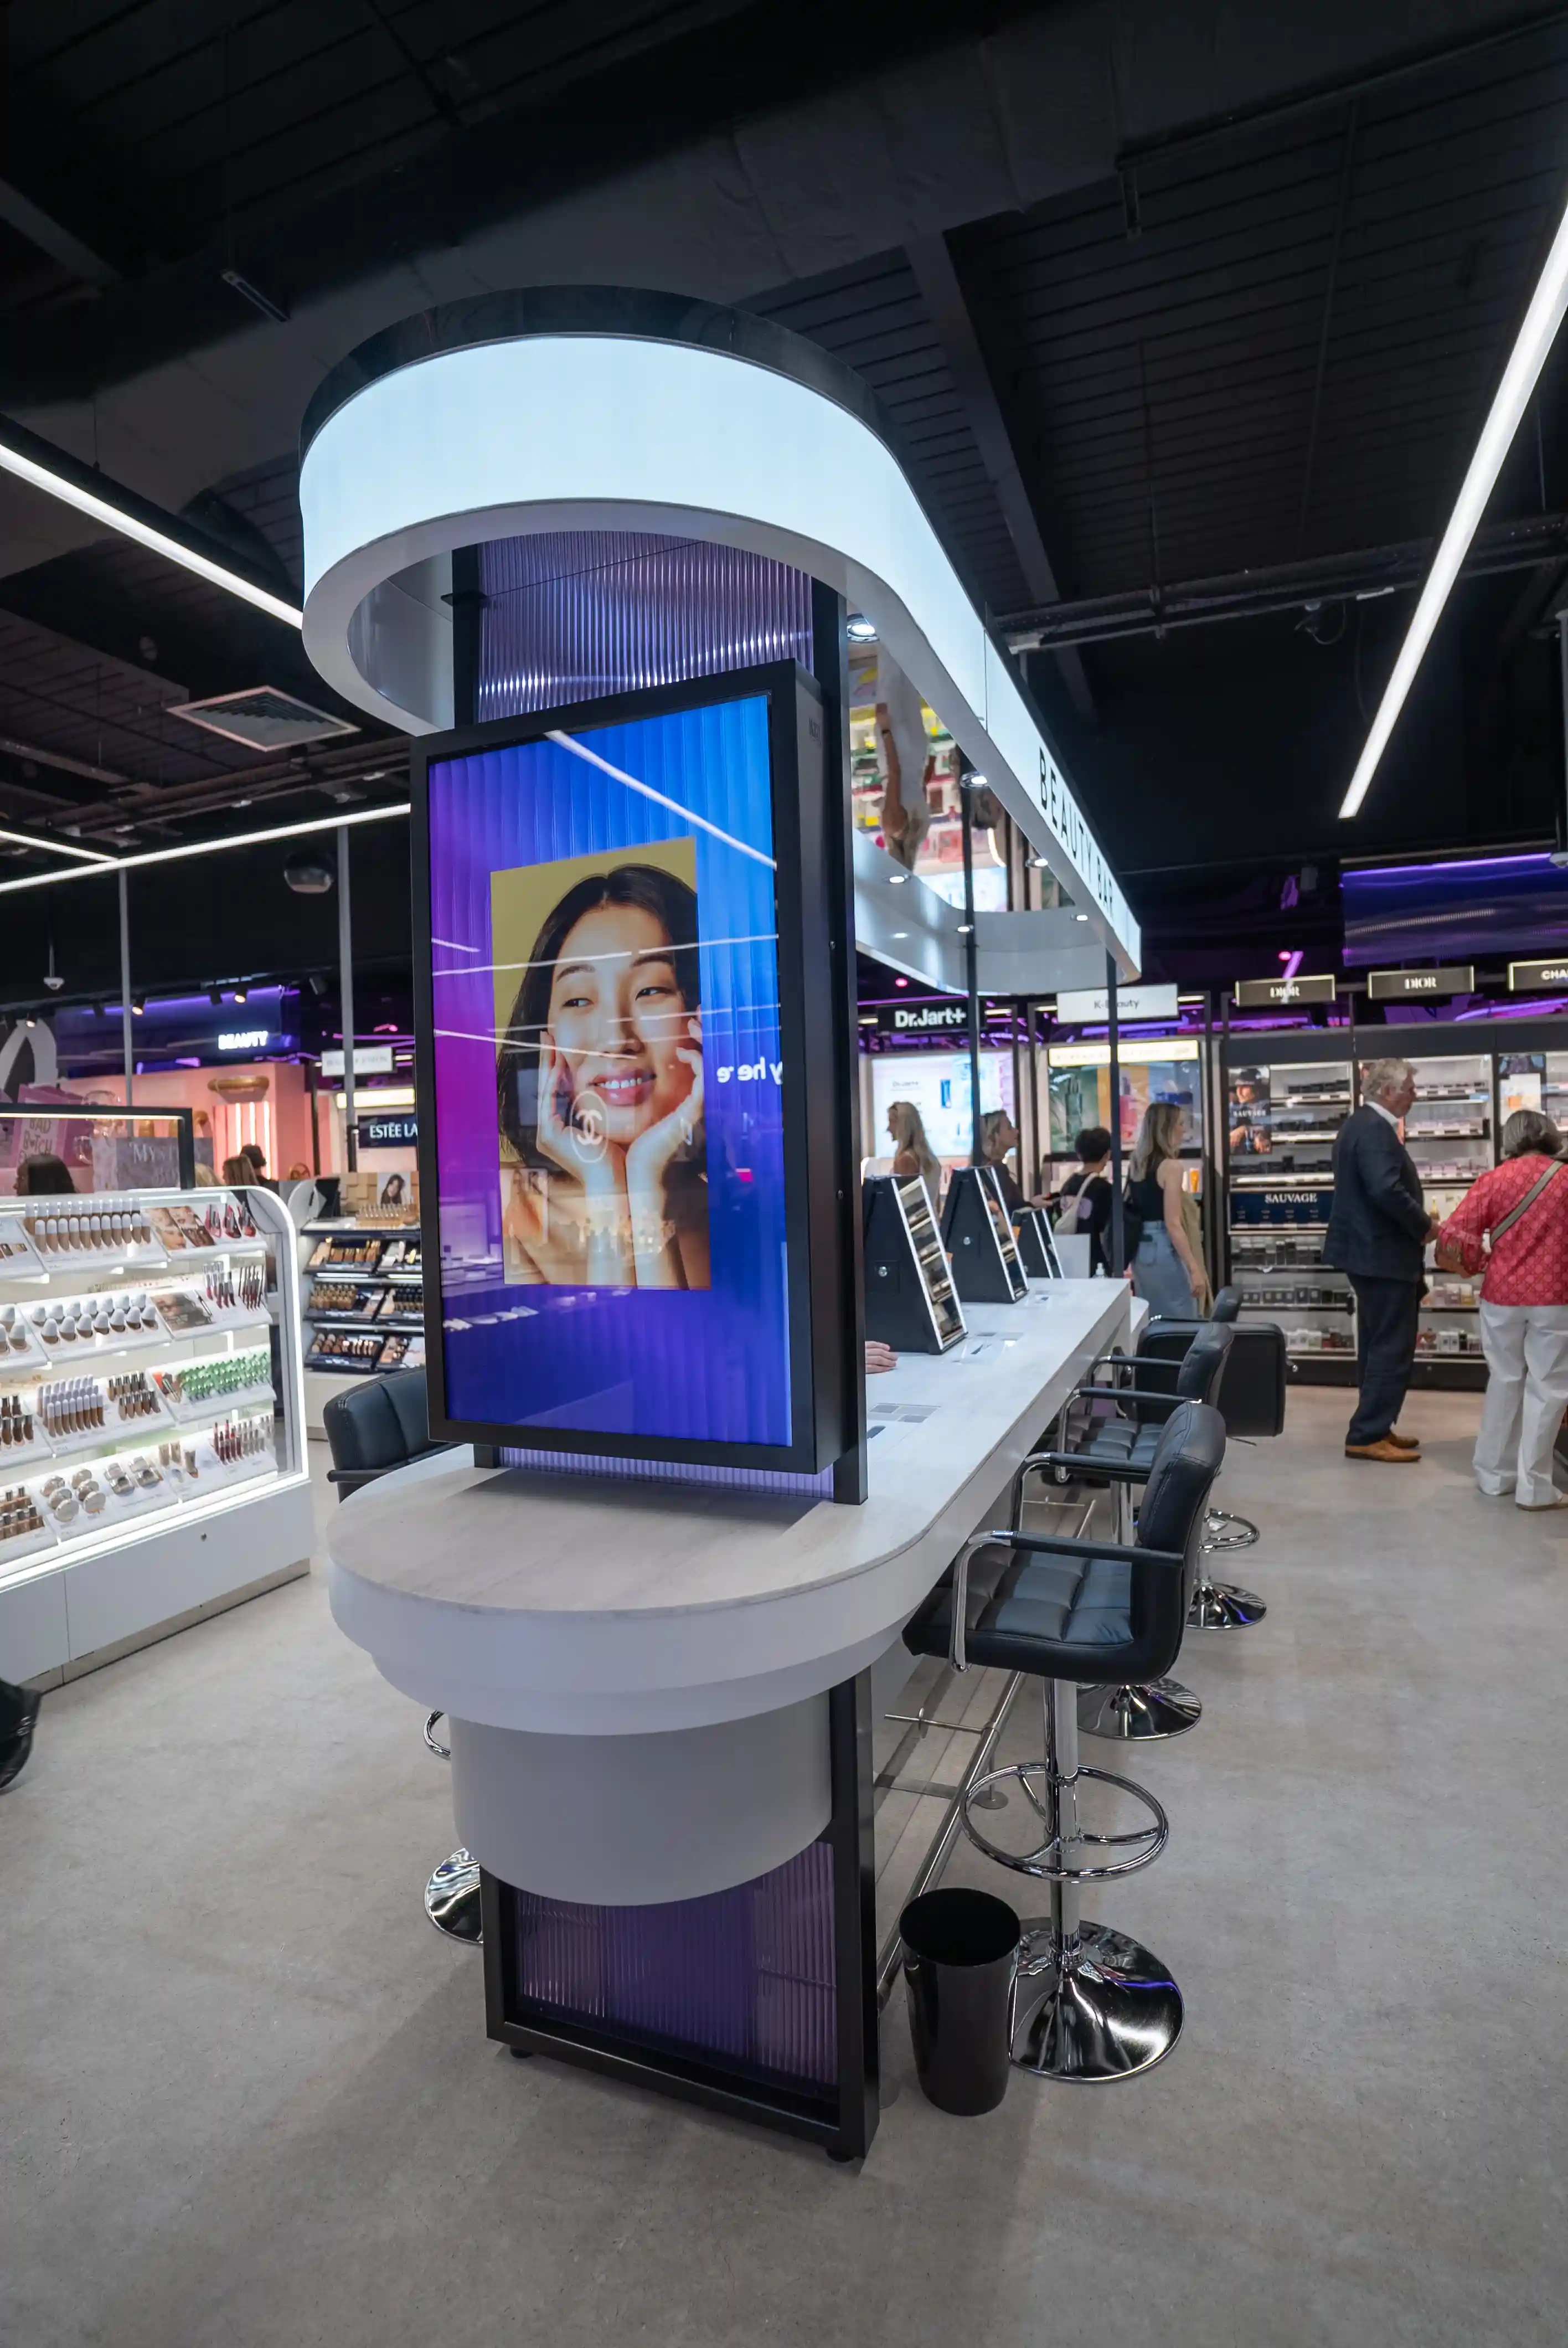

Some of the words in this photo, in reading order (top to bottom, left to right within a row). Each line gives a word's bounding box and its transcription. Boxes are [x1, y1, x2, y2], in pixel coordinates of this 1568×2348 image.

[1039, 746, 1091, 884] BEAUTY
[1097, 855, 1113, 922] BAR
[1540, 969, 1568, 980] CHA
[1404, 976, 1437, 990] DIOR
[1094, 998, 1140, 1010] K-auty
[894, 1006, 967, 1028] Dr.Jart+
[369, 1121, 403, 1139] ESTÉE
[1264, 1192, 1318, 1204] SAUVAGE
